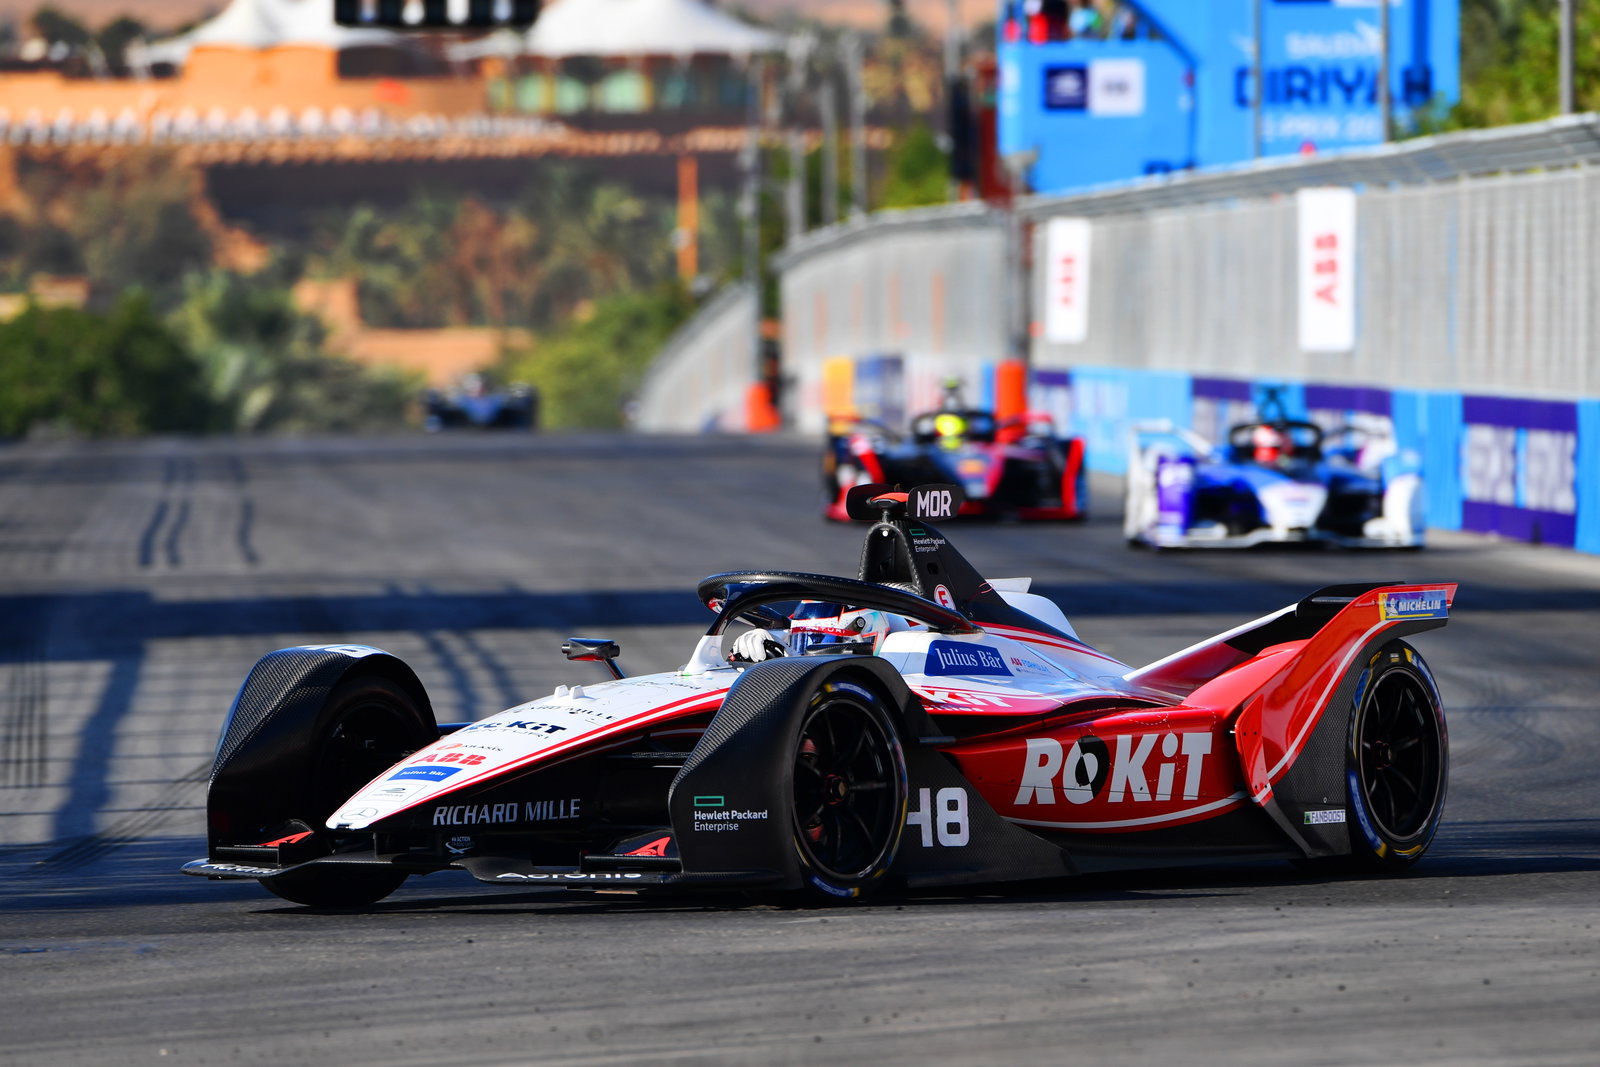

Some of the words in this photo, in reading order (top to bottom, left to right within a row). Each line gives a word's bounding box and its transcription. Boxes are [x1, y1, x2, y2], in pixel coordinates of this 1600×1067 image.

[917, 490, 952, 517] MOR
[1398, 600, 1441, 612] MICHELIN
[935, 648, 978, 669] Julius
[977, 651, 1003, 669] Bär
[409, 752, 487, 766] ABB
[1013, 732, 1213, 805] ROKiT
[432, 802, 518, 826] RICHARD
[525, 798, 581, 822] MILLE
[694, 810, 730, 820] Hewlett
[731, 810, 768, 820] Packard
[1312, 810, 1345, 823] FANBOOST
[694, 821, 739, 832] Enterprise
